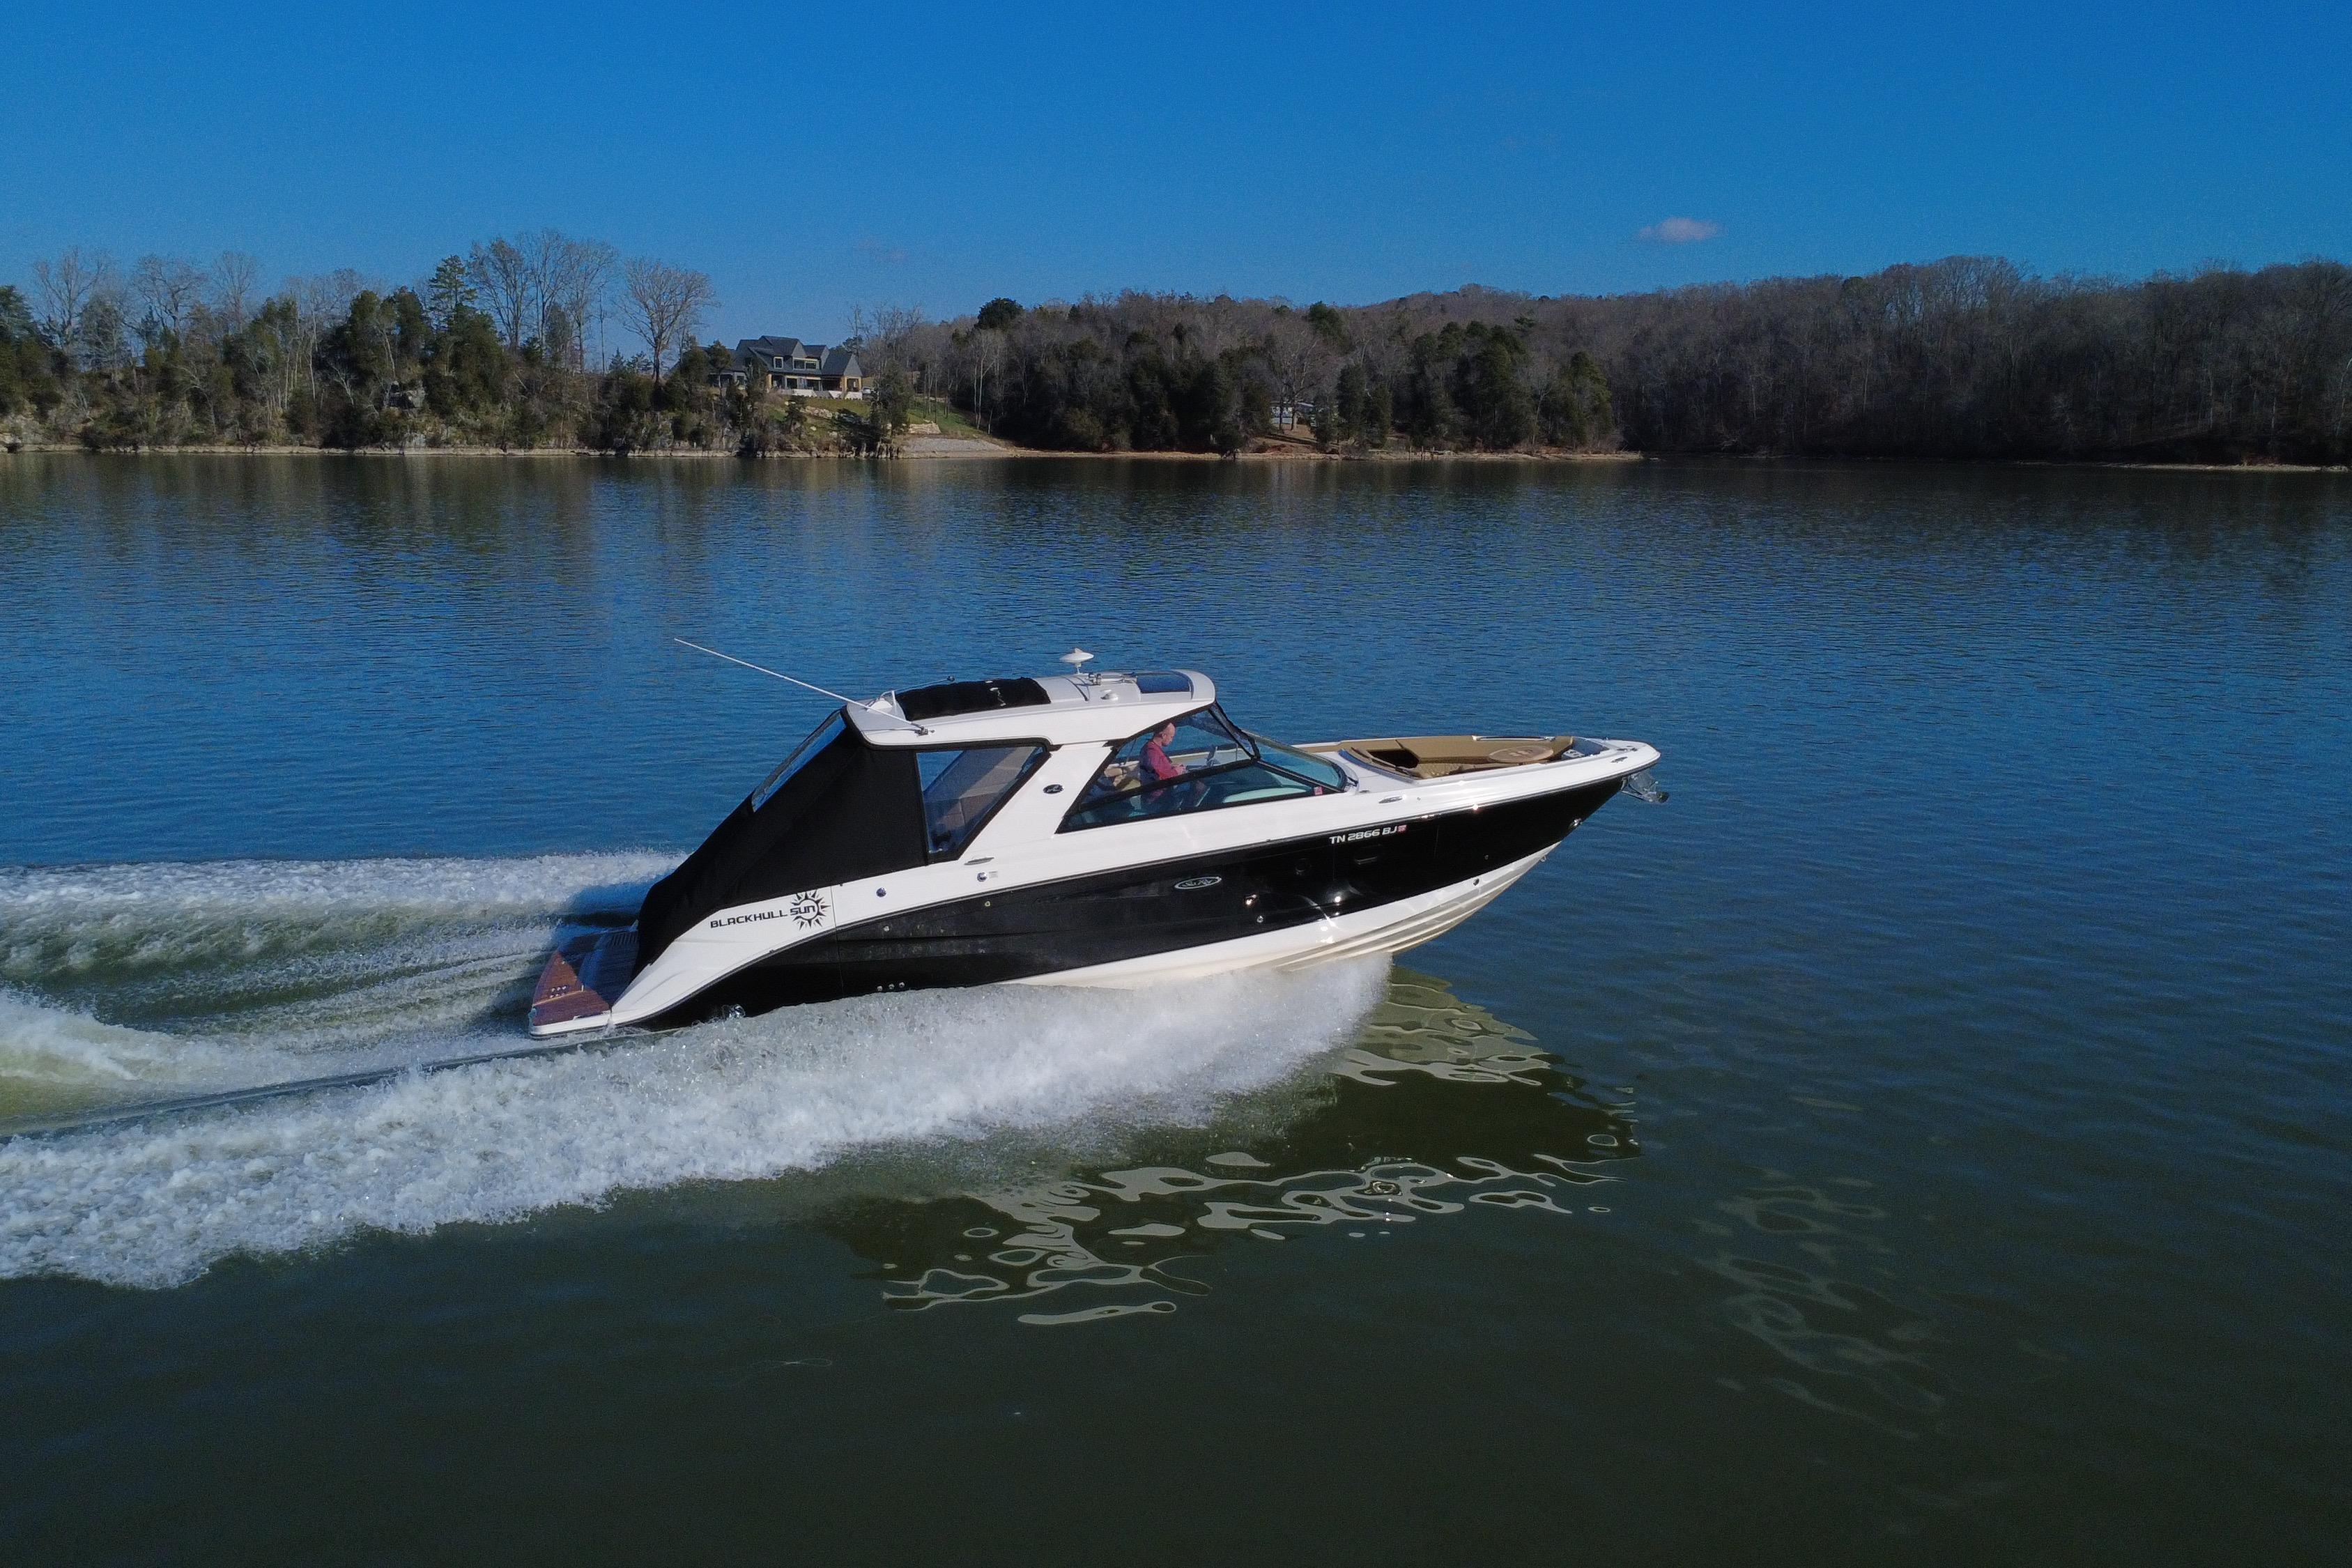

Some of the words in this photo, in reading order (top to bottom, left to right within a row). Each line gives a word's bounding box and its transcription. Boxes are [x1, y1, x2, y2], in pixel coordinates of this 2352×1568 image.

[1329, 834, 1345, 845] TN
[1347, 829, 1380, 840] 2866
[1382, 826, 1398, 836] BJ
[709, 909, 787, 928] BLACKHULL
